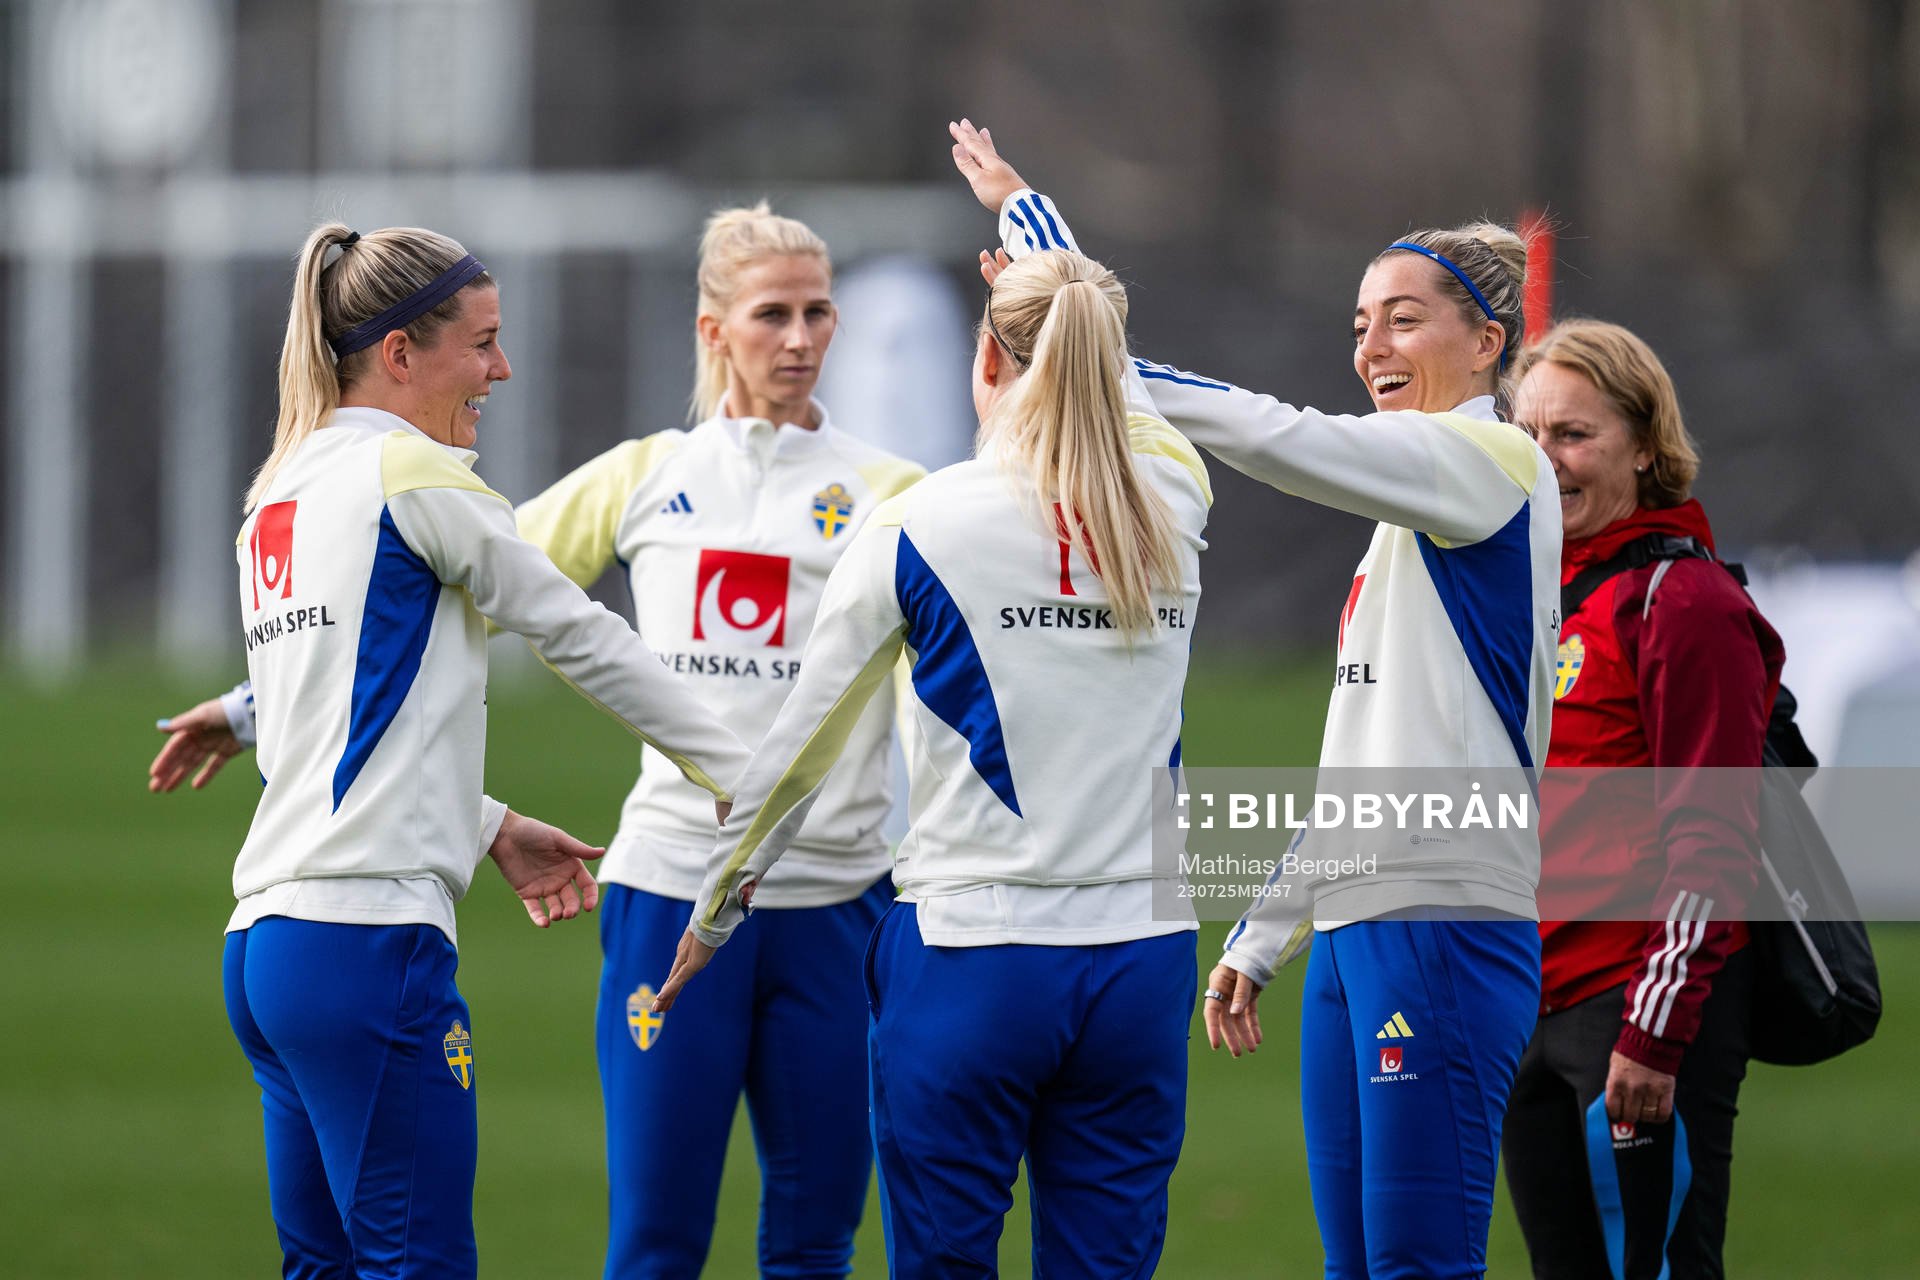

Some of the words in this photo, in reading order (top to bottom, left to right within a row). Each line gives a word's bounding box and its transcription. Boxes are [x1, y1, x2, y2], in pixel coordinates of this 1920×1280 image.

[286, 605, 336, 633] SPEL
[1000, 606, 1132, 629] SVENSK
[1149, 607, 1185, 629] PEL
[658, 653, 760, 678] VENSKA
[771, 660, 801, 681] SP
[1338, 663, 1377, 687] PEL
[1370, 1074, 1398, 1084] SVENSKA
[1399, 1072, 1419, 1081] SPEL
